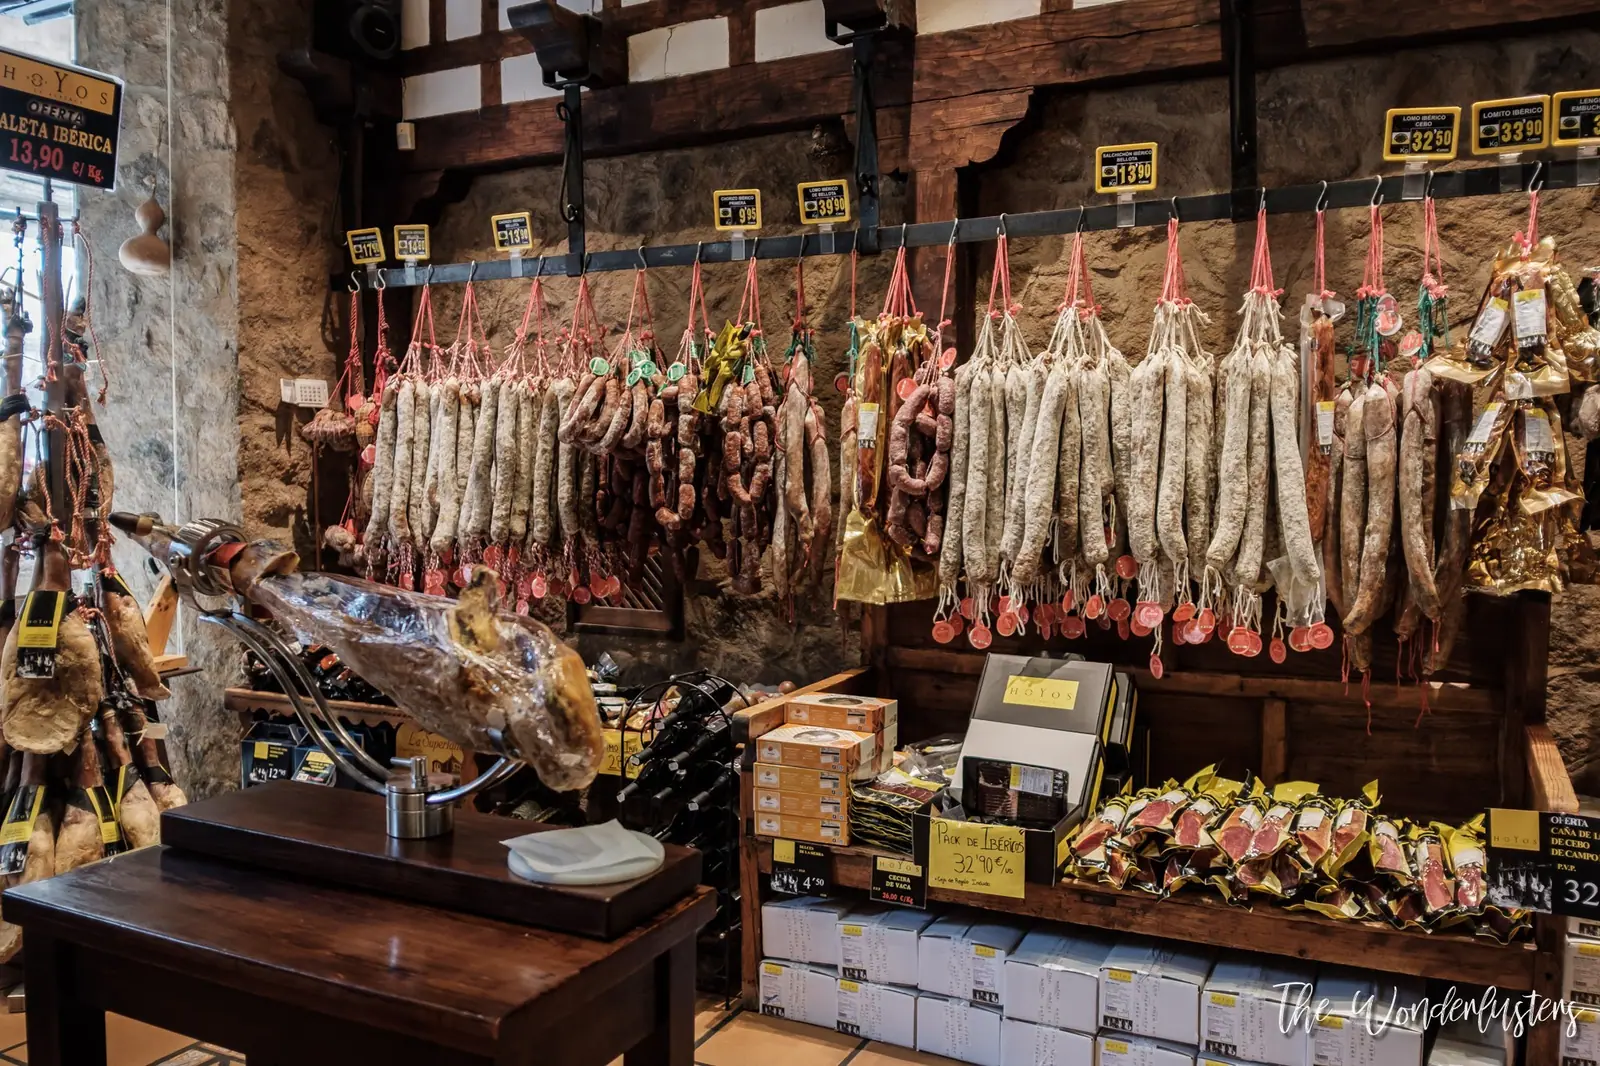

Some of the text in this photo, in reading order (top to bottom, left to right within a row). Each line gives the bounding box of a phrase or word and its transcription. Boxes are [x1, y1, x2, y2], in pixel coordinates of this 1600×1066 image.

[3, 64, 108, 105] HOYOS
[28, 101, 83, 124] OFERTA
[1483, 106, 1543, 119] LOMITO IBÉRICO
[1501, 119, 1542, 143] 33'90
[53, 124, 112, 154] IBÉRICA
[1412, 129, 1452, 152] 32'50
[9, 138, 64, 171] 13,90
[1119, 163, 1151, 185] 13'90
[819, 197, 846, 216] 39'90
[739, 206, 757, 224] 9'95
[1009, 687, 1072, 701] HOYOS
[1550, 816, 1589, 827] OFERTA
[1550, 826, 1577, 837] CAÑA
[1579, 830, 1592, 839] DE
[967, 837, 979, 847] DE
[1494, 835, 1538, 845] HOYOS
[1551, 837, 1591, 850] DE CEBO
[1551, 848, 1599, 861] DE CAMPO
[880, 861, 920, 873] HOYOS
[803, 877, 825, 889] 4'50
[888, 874, 911, 883] CECINA
[895, 882, 911, 890] VACA
[1564, 879, 1600, 906] 32
